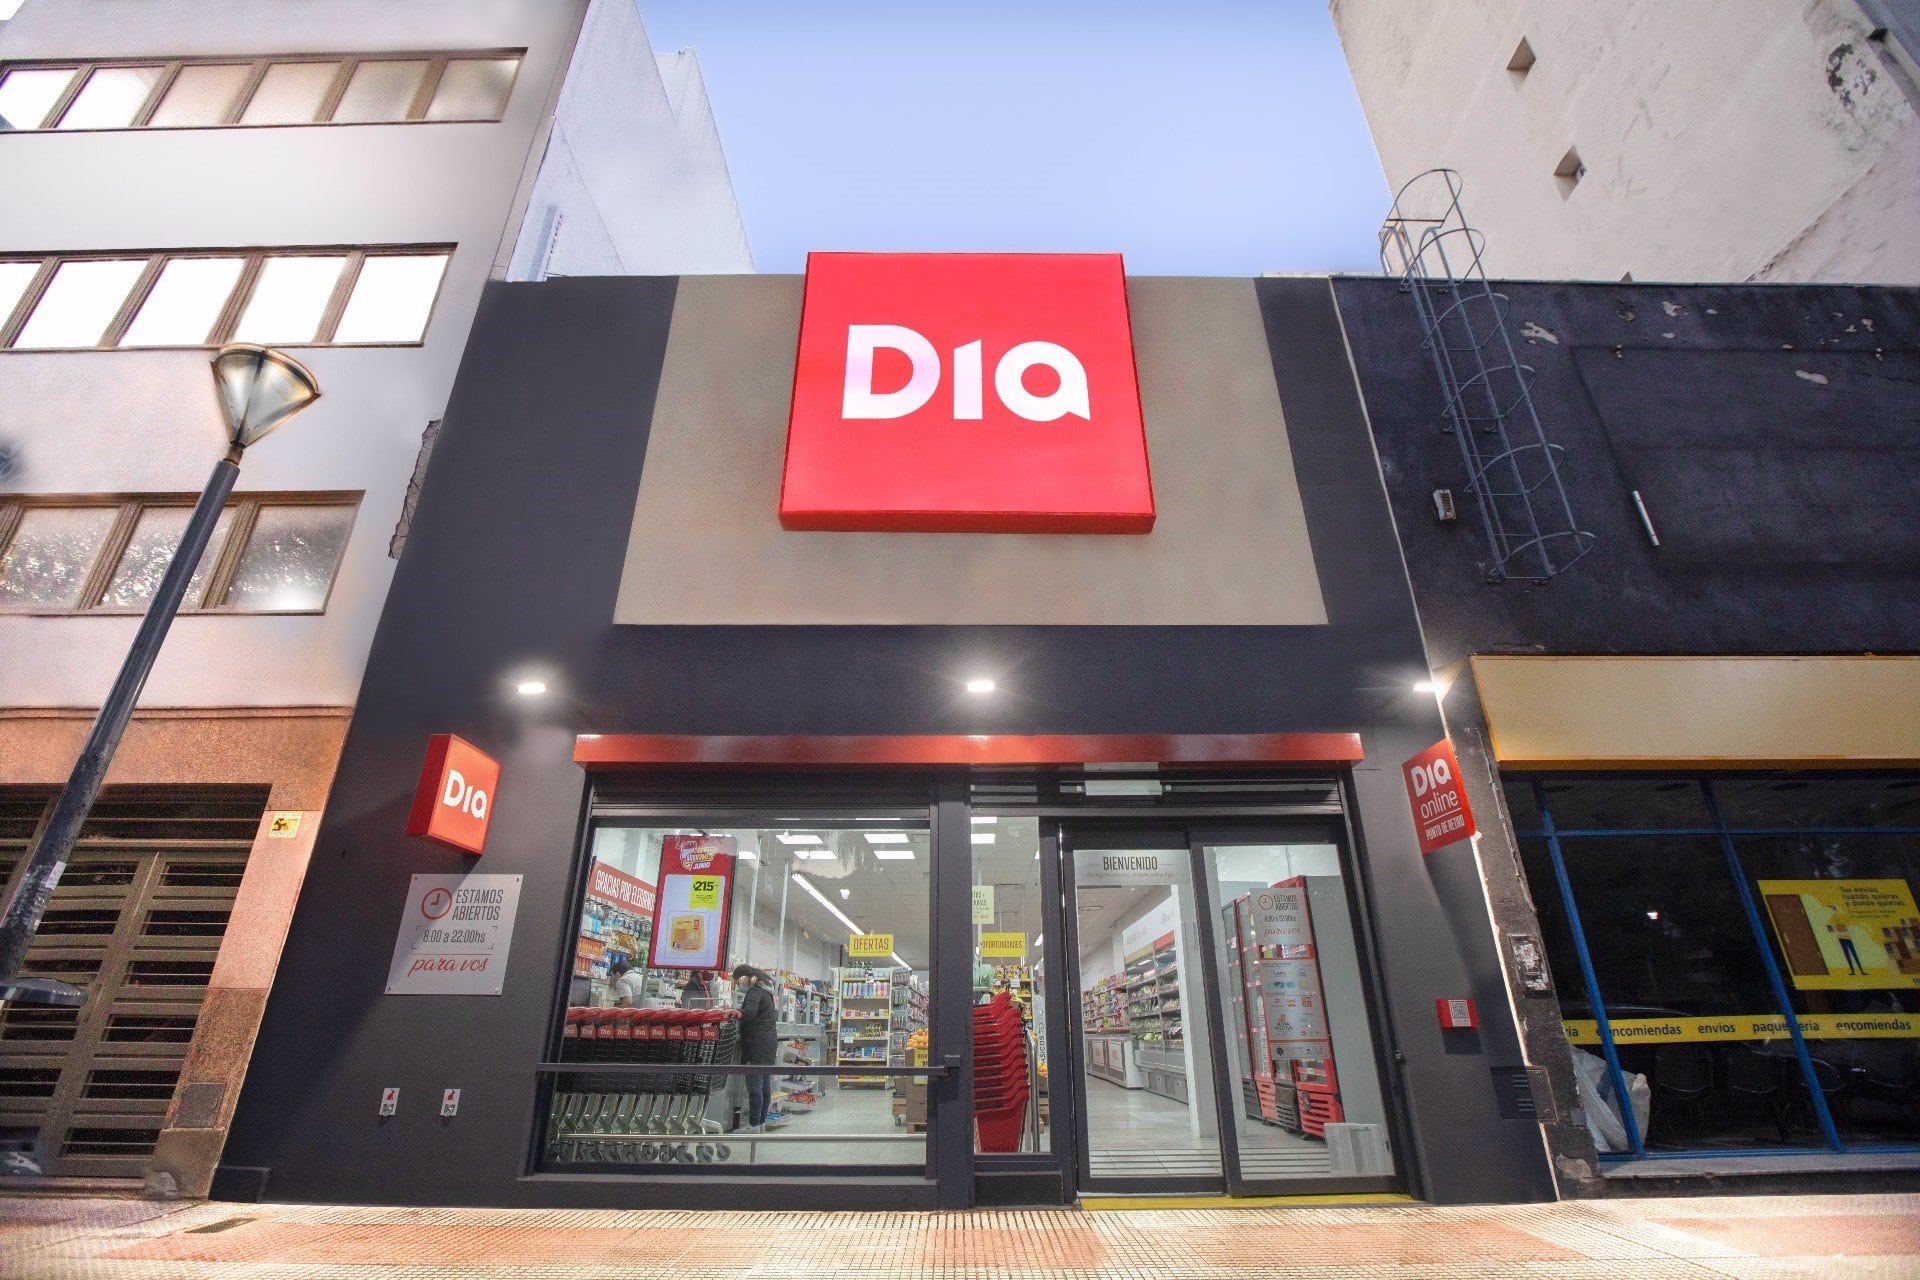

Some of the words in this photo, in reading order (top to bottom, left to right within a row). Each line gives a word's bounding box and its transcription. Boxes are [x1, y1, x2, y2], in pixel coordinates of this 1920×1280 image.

[842, 324, 1091, 422] Dia
[1410, 758, 1452, 798] Dia
[443, 768, 488, 821] Dia
[1420, 790, 1459, 819] online
[1103, 856, 1159, 871] BIENVENIDO
[455, 889, 504, 904] ESTAMOS
[451, 905, 501, 921] ABIERTOS
[443, 933, 451, 943] a
[853, 937, 889, 950] OFERTAS
[407, 957, 459, 978] para
[460, 957, 489, 972] vos
